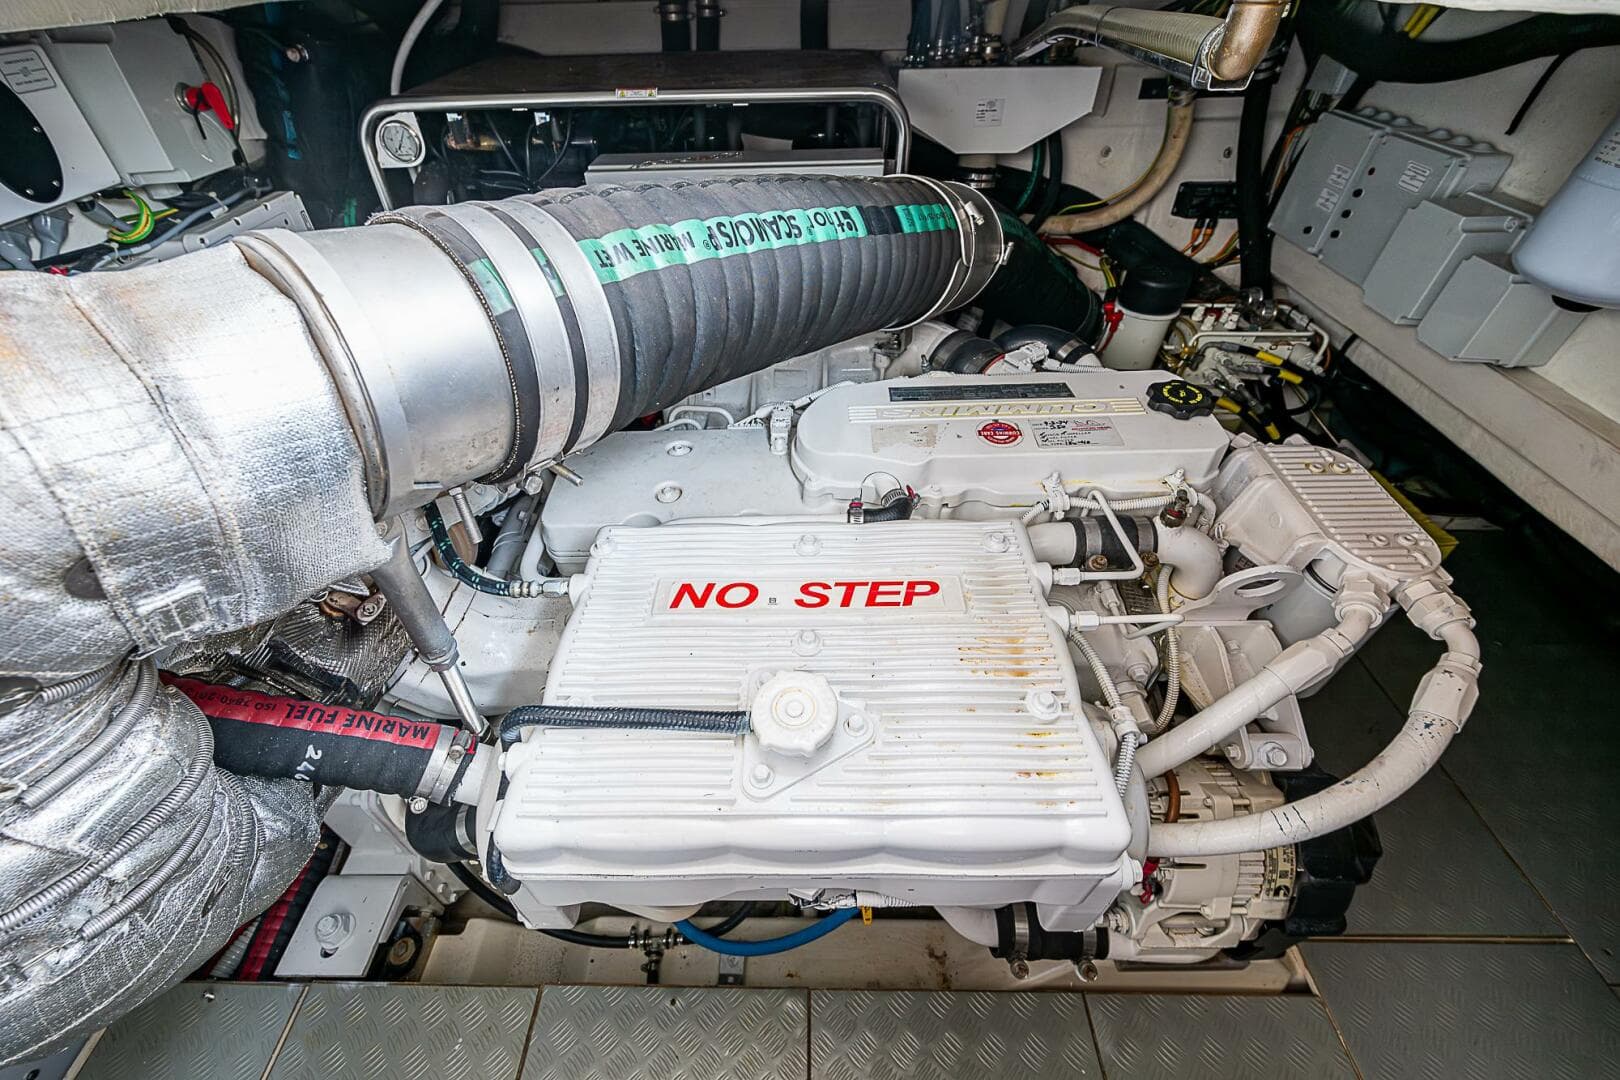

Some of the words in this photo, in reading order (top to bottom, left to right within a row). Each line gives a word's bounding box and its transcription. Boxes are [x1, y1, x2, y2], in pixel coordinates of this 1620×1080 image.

[594, 243, 636, 269] WET
[635, 229, 696, 258] MARINE
[879, 401, 1107, 418] CUMMINS
[668, 581, 759, 609] NO
[793, 580, 941, 609] STEP
[254, 700, 278, 713] ISO
[284, 702, 340, 725] FUEL
[343, 712, 431, 742] MARINE
